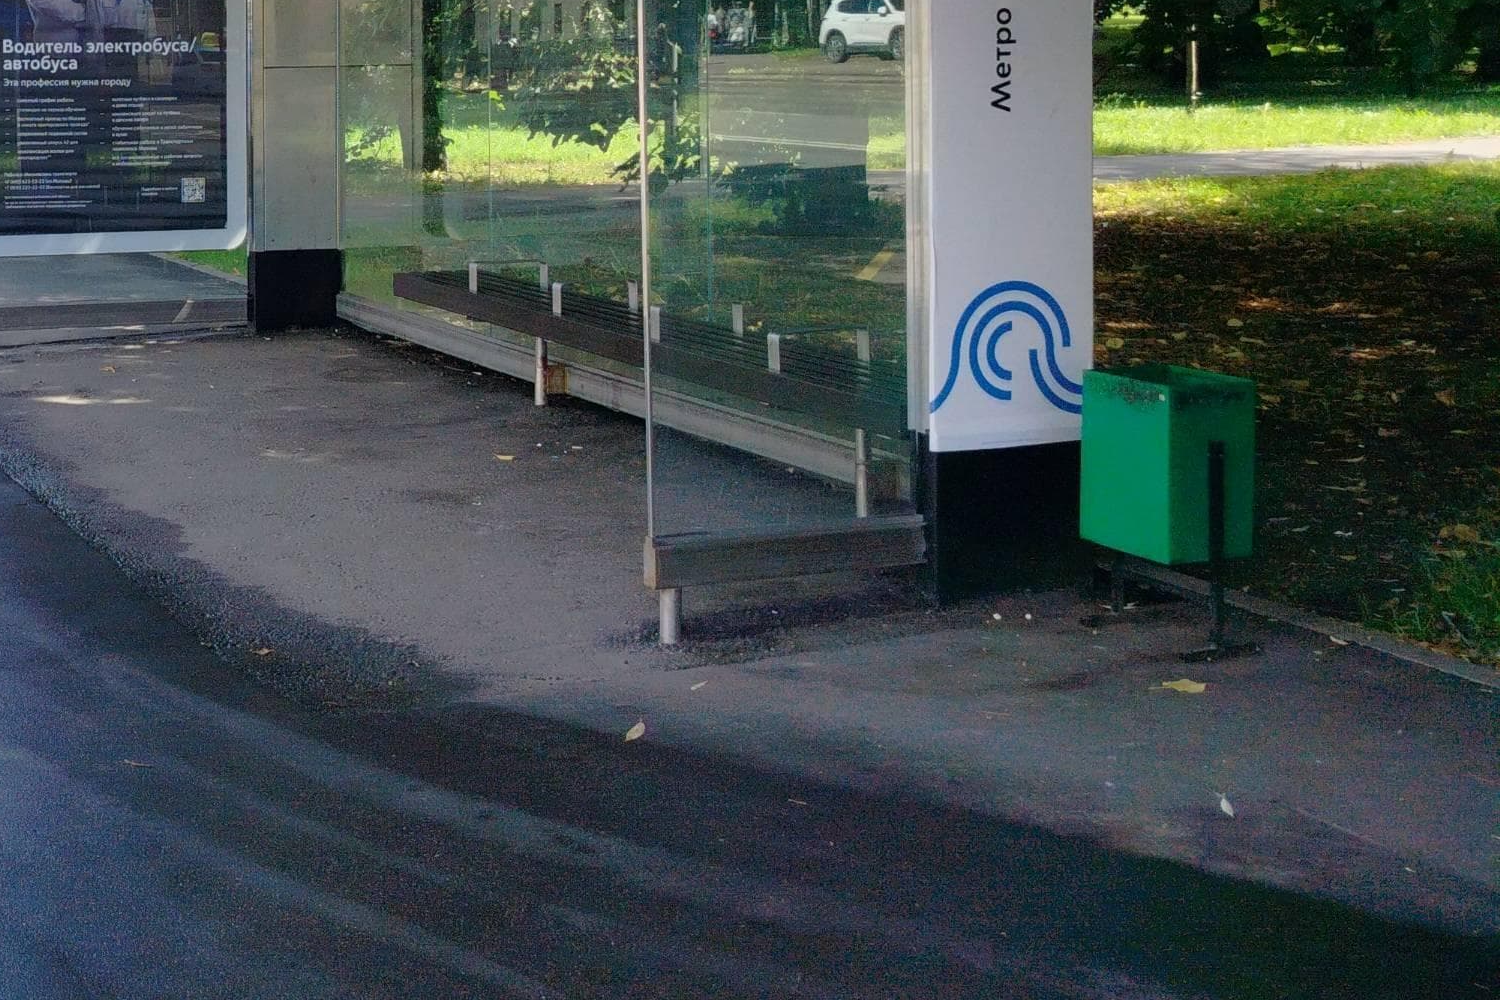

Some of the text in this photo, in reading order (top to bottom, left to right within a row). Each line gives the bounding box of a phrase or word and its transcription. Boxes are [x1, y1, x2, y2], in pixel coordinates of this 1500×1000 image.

[2, 36, 197, 56] Водитель электробуса/
[3, 55, 79, 73] автобуса
[990, 7, 1017, 113] Метро
[3, 77, 132, 88] Эта профессия нужна городу
